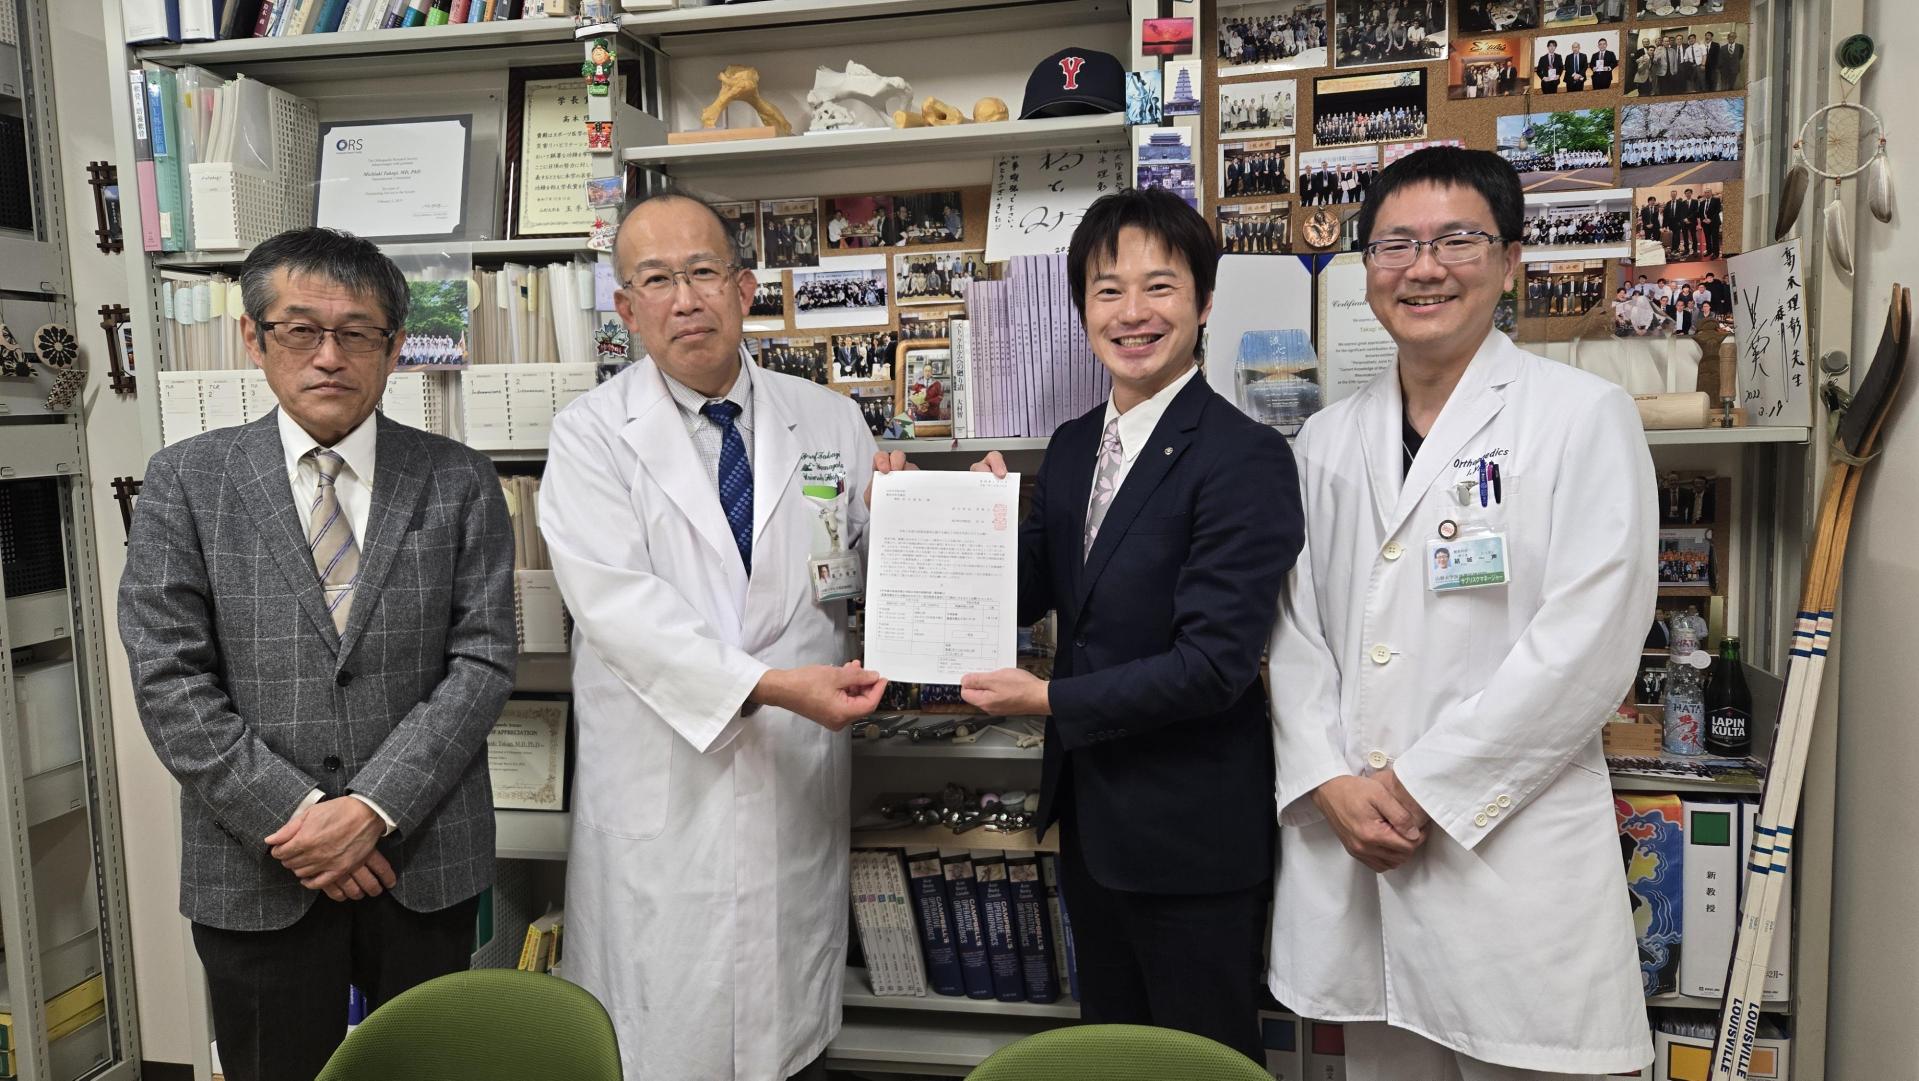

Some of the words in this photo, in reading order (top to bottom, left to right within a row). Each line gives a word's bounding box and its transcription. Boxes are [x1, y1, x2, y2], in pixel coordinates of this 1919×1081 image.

[1058, 56, 1085, 90] Y
[336, 138, 363, 152] ORS
[1673, 703, 1703, 714] HATA
[1712, 715, 1745, 728] LAPIN
[1712, 725, 1746, 737] KULTA
[1705, 870, 1716, 913] 新教授
[935, 896, 950, 944] CAMPBELL'S
[969, 898, 983, 947] CAMPBELL'S
[1001, 900, 1014, 950] CAMPBELL'S
[1032, 902, 1045, 951] CAMPBELL'S
[1720, 997, 1743, 1073] LOUISVILLE
[1736, 1001, 1760, 1079] LOUISVILLE
